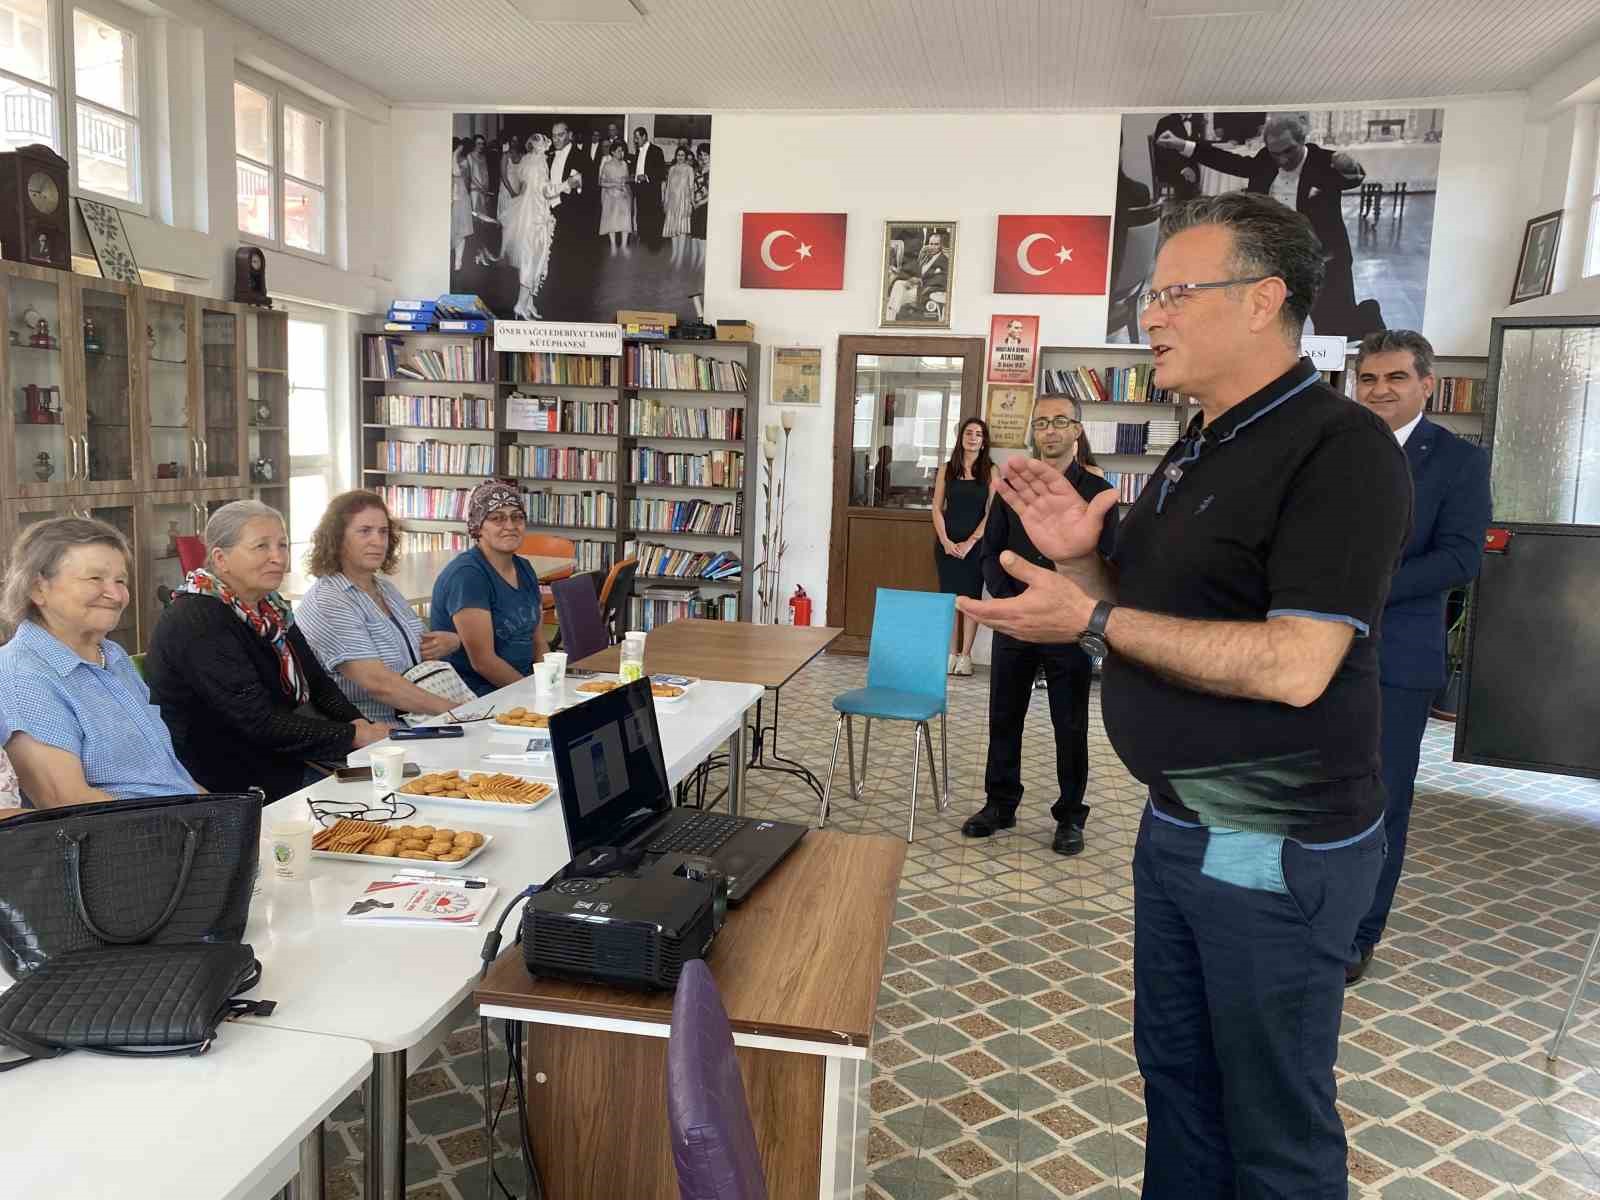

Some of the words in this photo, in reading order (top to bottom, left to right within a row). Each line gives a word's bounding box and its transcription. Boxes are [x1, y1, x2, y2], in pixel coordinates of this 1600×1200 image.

[498, 326, 521, 336] ÖNER
[589, 329, 617, 339] TARİHİ
[529, 339, 586, 348] KÜTÜPHANESİ
[1000, 353, 1024, 361] ATATÜRK
